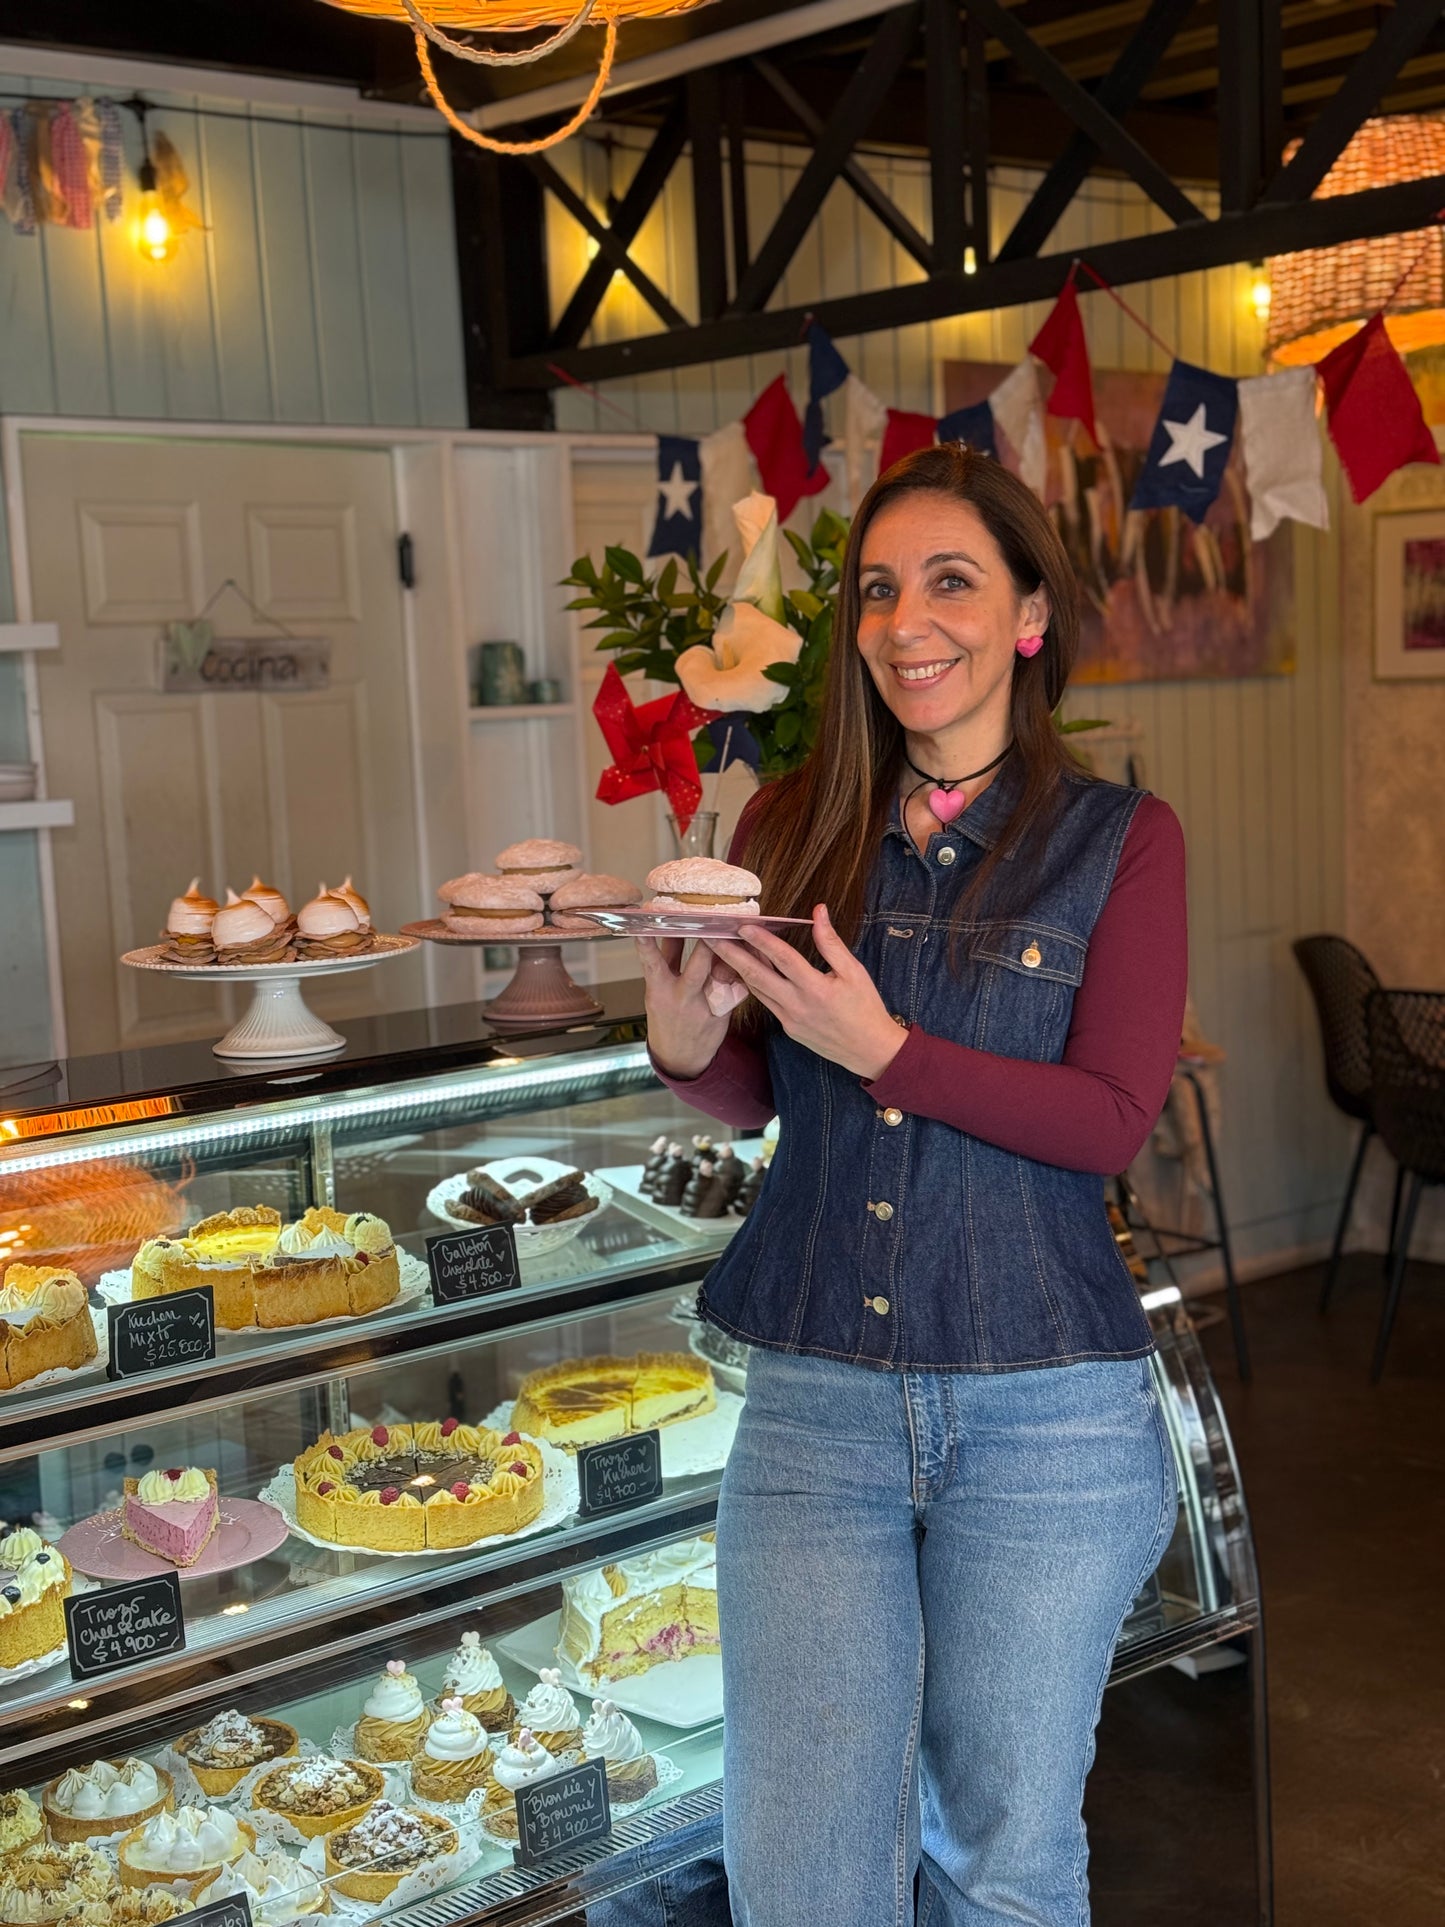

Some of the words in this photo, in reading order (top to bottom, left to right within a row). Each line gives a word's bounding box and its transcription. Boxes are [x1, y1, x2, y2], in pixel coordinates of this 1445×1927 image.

[127, 1310, 182, 1329] Kuchen
[80, 1595, 146, 1625] Trozo
[528, 1778, 584, 1815] Blondie
[536, 1797, 595, 1829] Brownie
